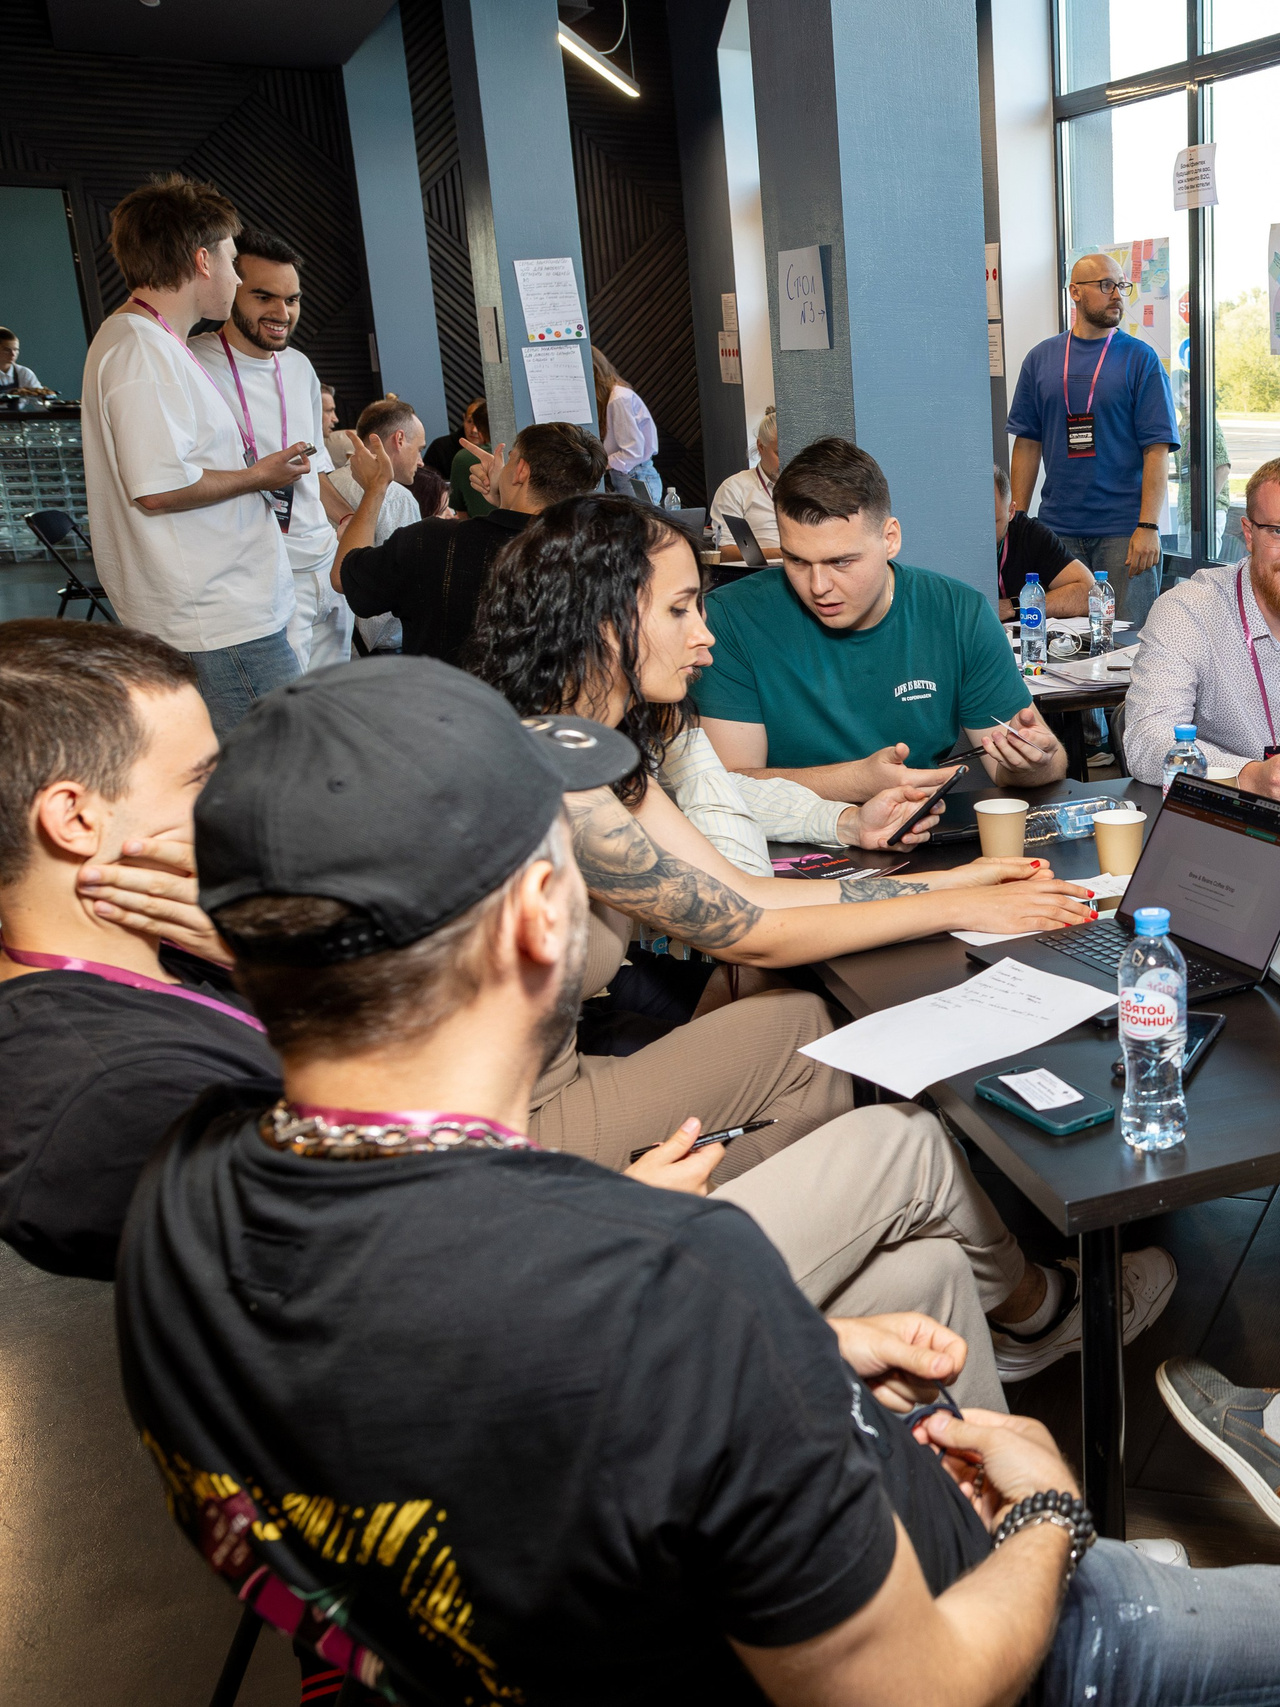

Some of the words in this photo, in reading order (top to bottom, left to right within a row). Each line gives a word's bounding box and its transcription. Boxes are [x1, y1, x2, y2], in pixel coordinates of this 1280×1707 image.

[894, 682, 908, 698] LIFE
[908, 681, 913, 691] IS
[913, 680, 937, 691] BETTER
[1188, 871, 1198, 880] Brew
[1202, 876, 1213, 886] Beans
[1213, 880, 1225, 890] Coffee
[1225, 884, 1235, 893] Shop
